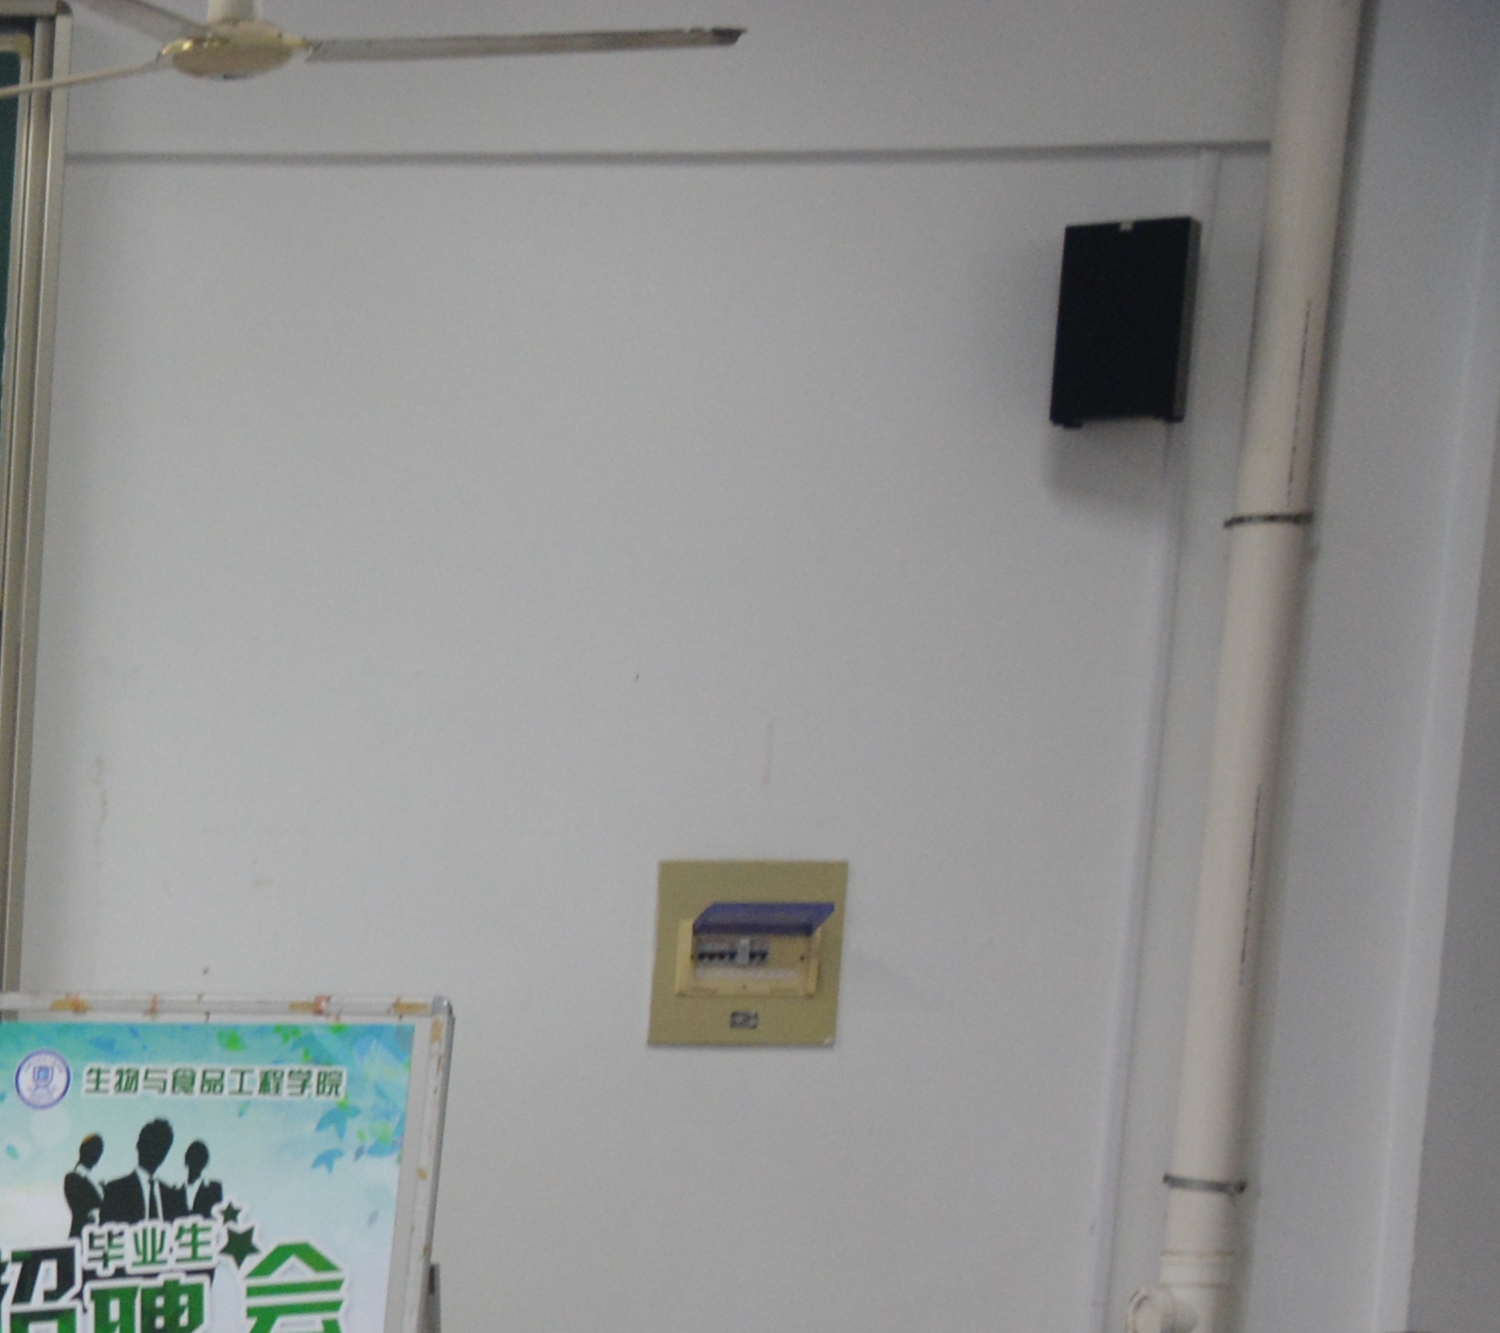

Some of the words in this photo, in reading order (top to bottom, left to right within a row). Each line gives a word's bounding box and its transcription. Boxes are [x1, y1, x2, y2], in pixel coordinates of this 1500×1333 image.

[83, 1064, 348, 1100] 生物与食品工程学院
[85, 1220, 218, 1274] 毕业生
